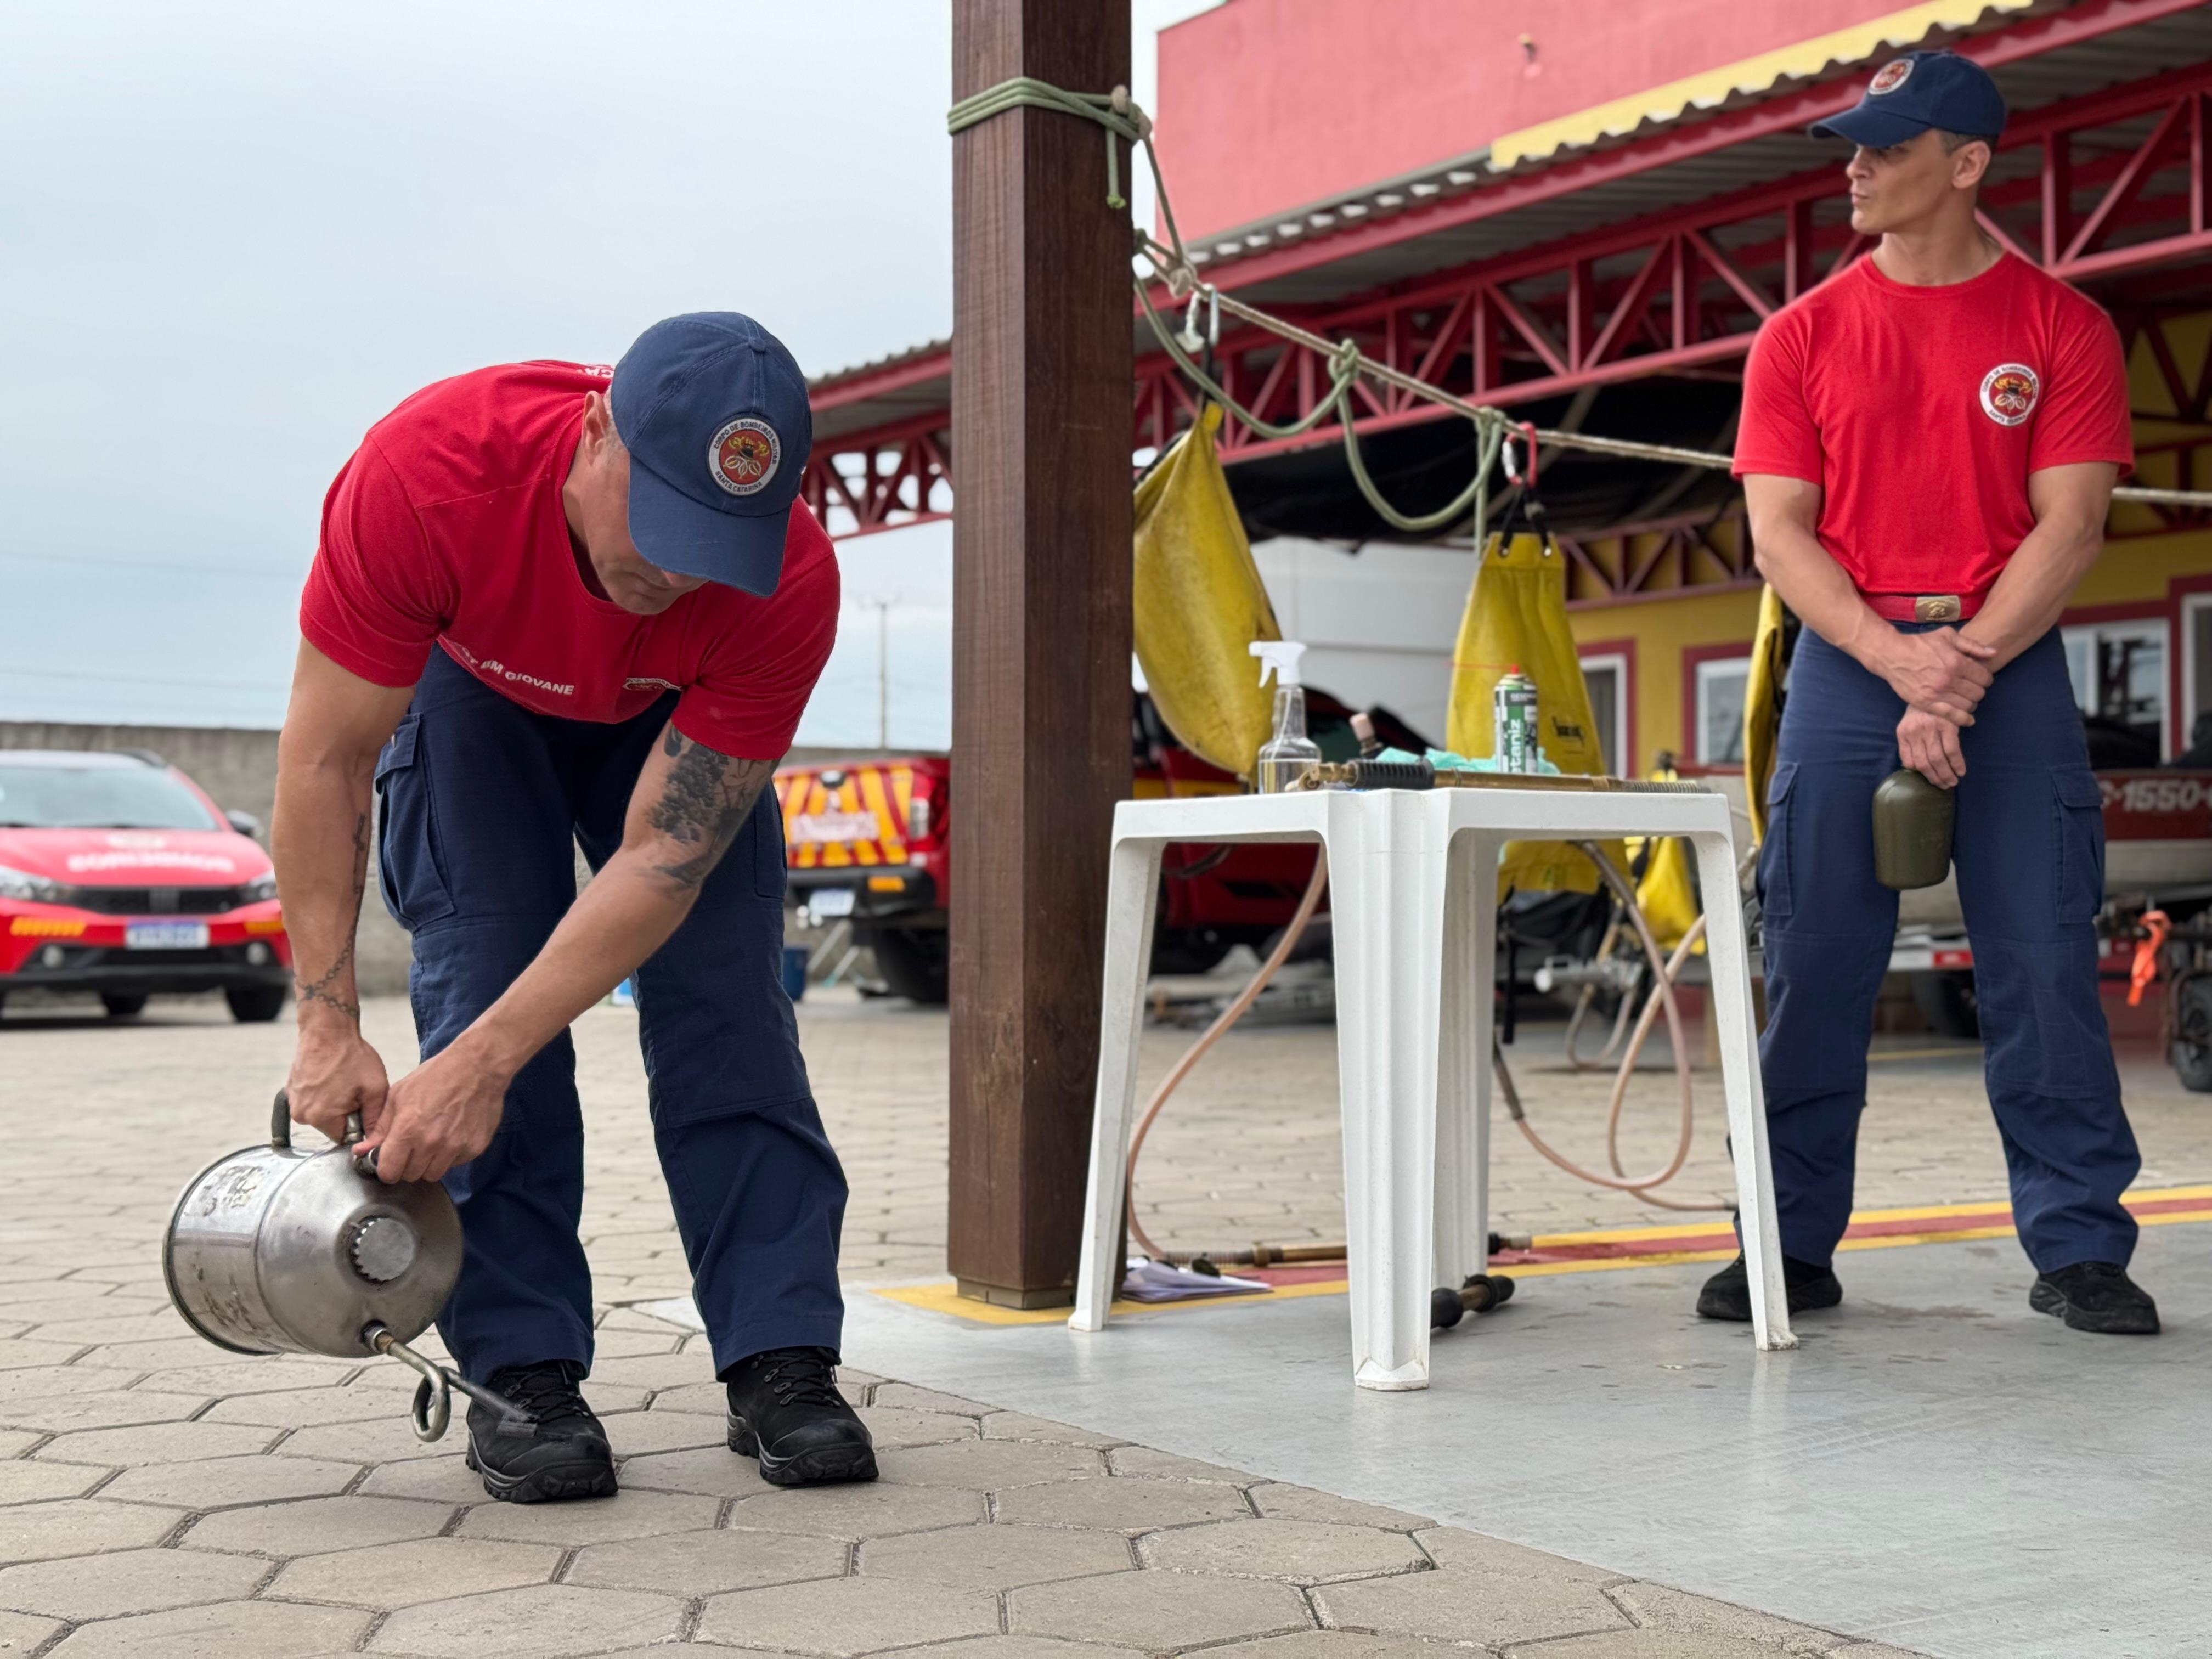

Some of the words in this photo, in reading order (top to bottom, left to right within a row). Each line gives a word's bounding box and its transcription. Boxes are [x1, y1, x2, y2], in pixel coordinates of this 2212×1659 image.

[714, 430, 730, 449] CORPO
[730, 424, 738, 432] DE
[740, 421, 774, 439] BOMBEIROS
[715, 471, 732, 489] SANTA
[733, 482, 763, 493] CATARINA
[505, 672, 575, 695] GIOVANE
